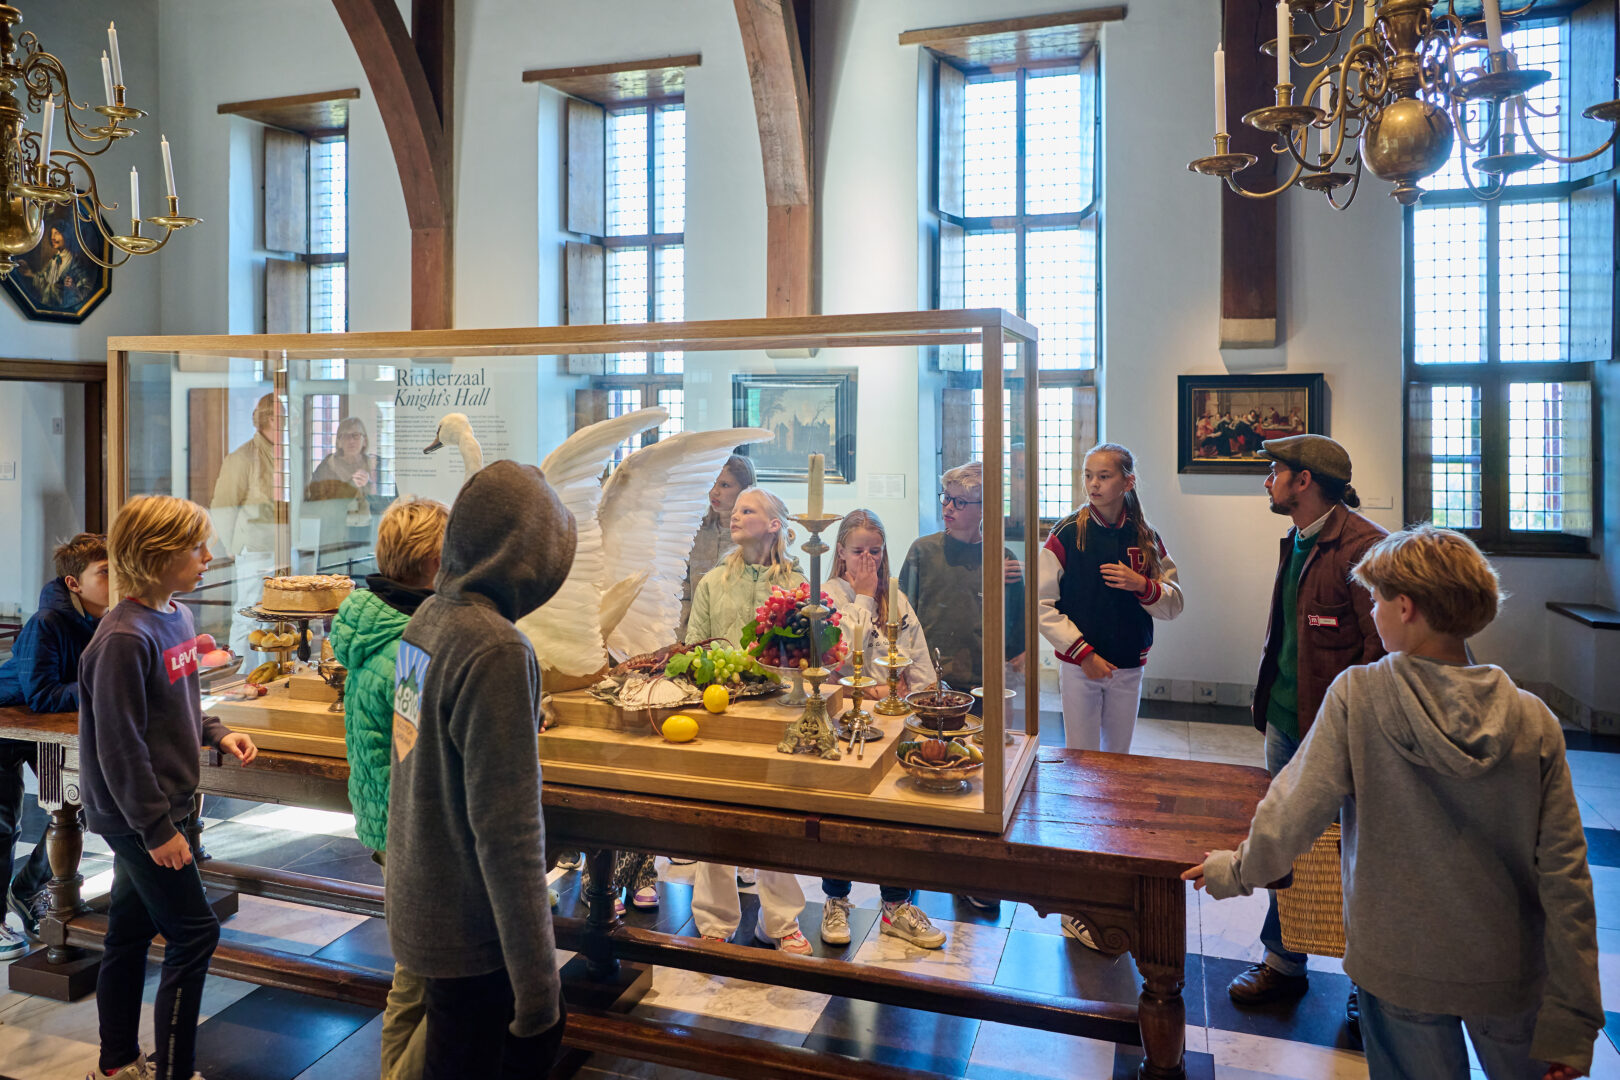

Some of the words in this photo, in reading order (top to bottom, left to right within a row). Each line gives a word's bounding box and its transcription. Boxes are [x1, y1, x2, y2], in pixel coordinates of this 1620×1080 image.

[397, 368, 485, 387] Ridderzaal
[395, 388, 451, 411] Knight's
[455, 387, 491, 407] Hall
